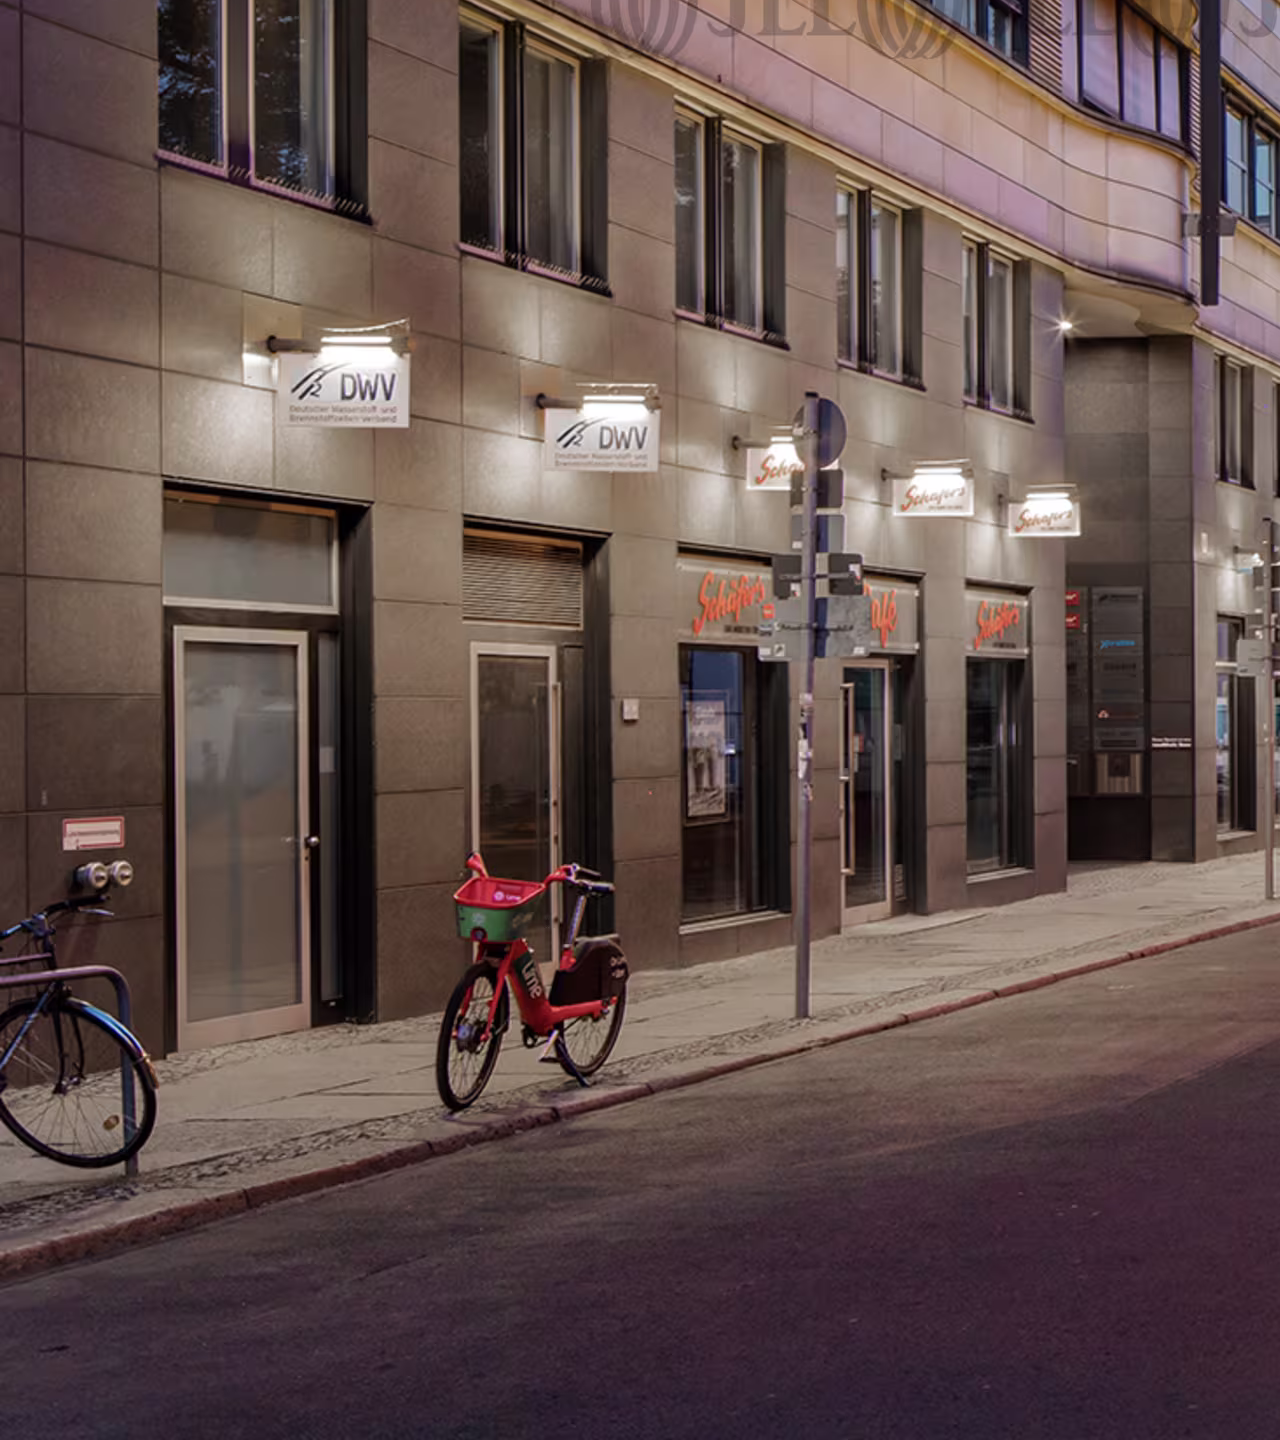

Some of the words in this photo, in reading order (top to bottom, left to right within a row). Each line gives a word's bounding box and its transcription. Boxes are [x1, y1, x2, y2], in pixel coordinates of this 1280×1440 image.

[341, 373, 396, 401] DWV
[599, 426, 648, 449] DWV
[864, 582, 898, 648] afé
